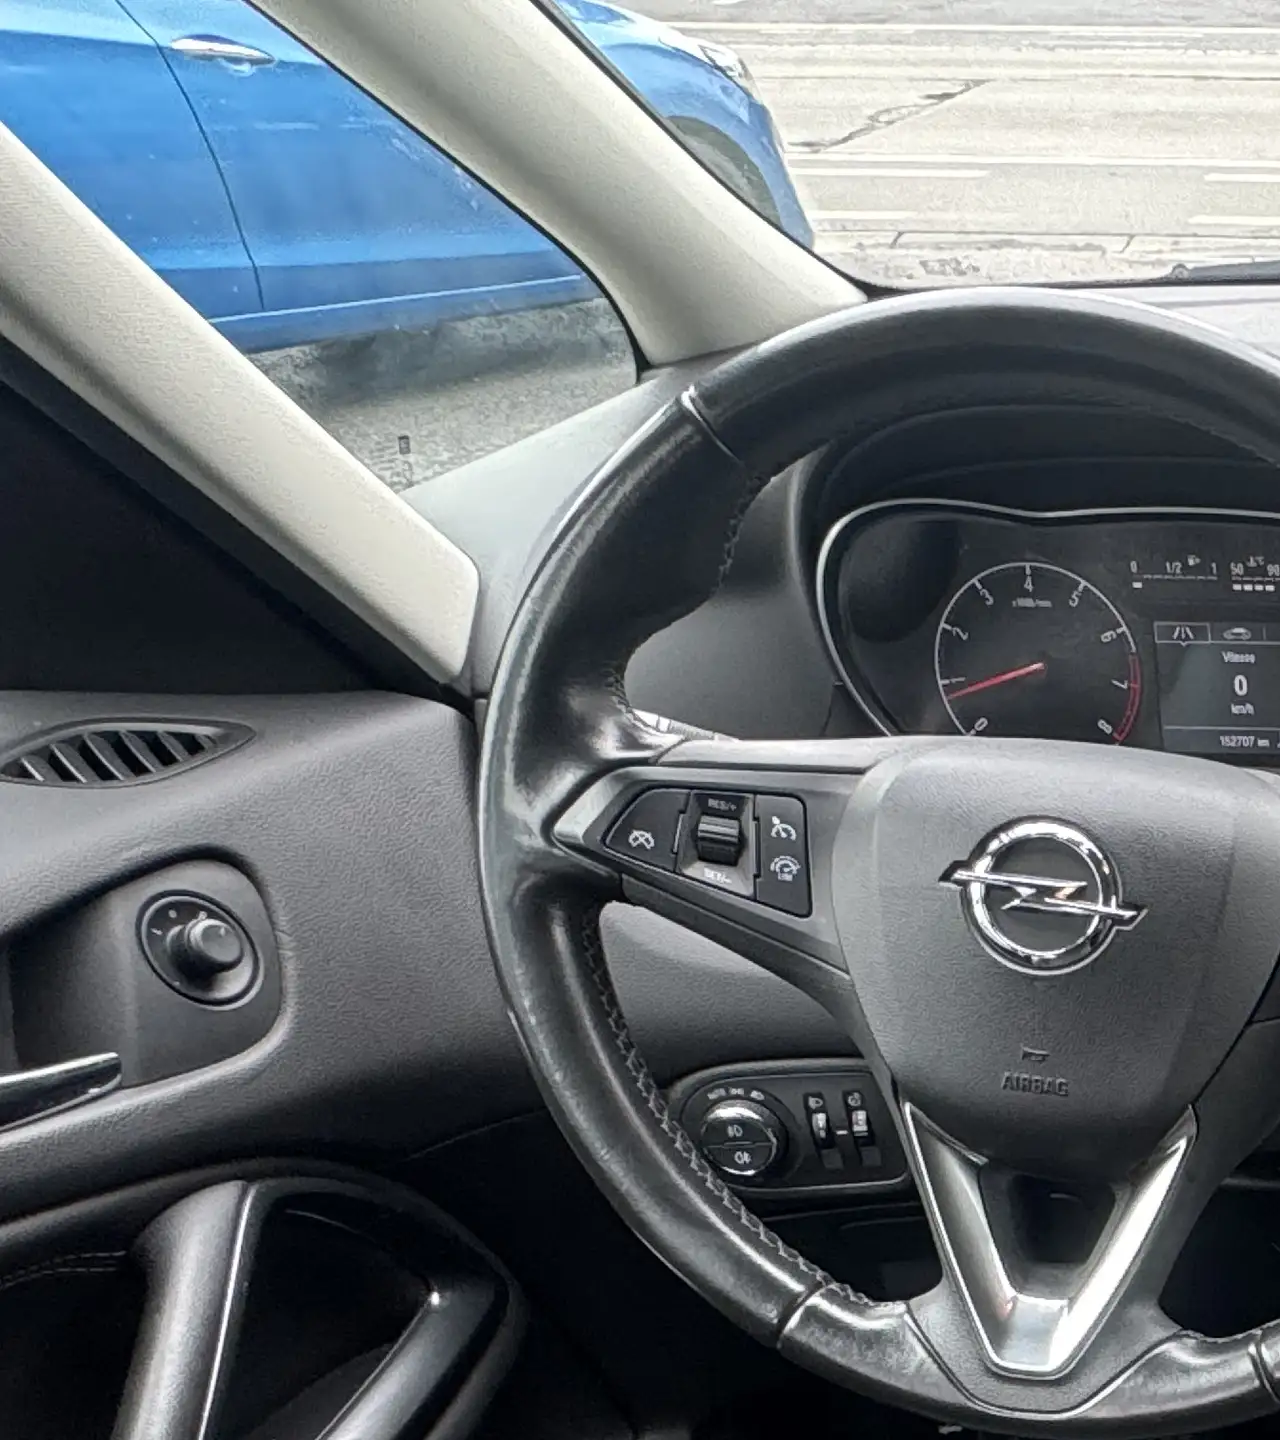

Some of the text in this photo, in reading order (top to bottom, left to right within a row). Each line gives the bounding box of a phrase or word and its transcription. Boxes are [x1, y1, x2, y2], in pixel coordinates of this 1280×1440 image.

[1129, 561, 1138, 573] 0
[1165, 561, 1183, 574] 1/2
[1267, 564, 1280, 577] 90
[1023, 576, 1034, 592] 4
[979, 588, 994, 606] 3
[1069, 591, 1080, 607] 5
[952, 627, 969, 640] 2
[1100, 629, 1117, 643] 6
[1112, 679, 1128, 690] 7
[1233, 674, 1249, 697] 0
[973, 716, 988, 732] 0
[1097, 719, 1113, 735] 8
[1001, 1071, 1069, 1097] AIRBAG
